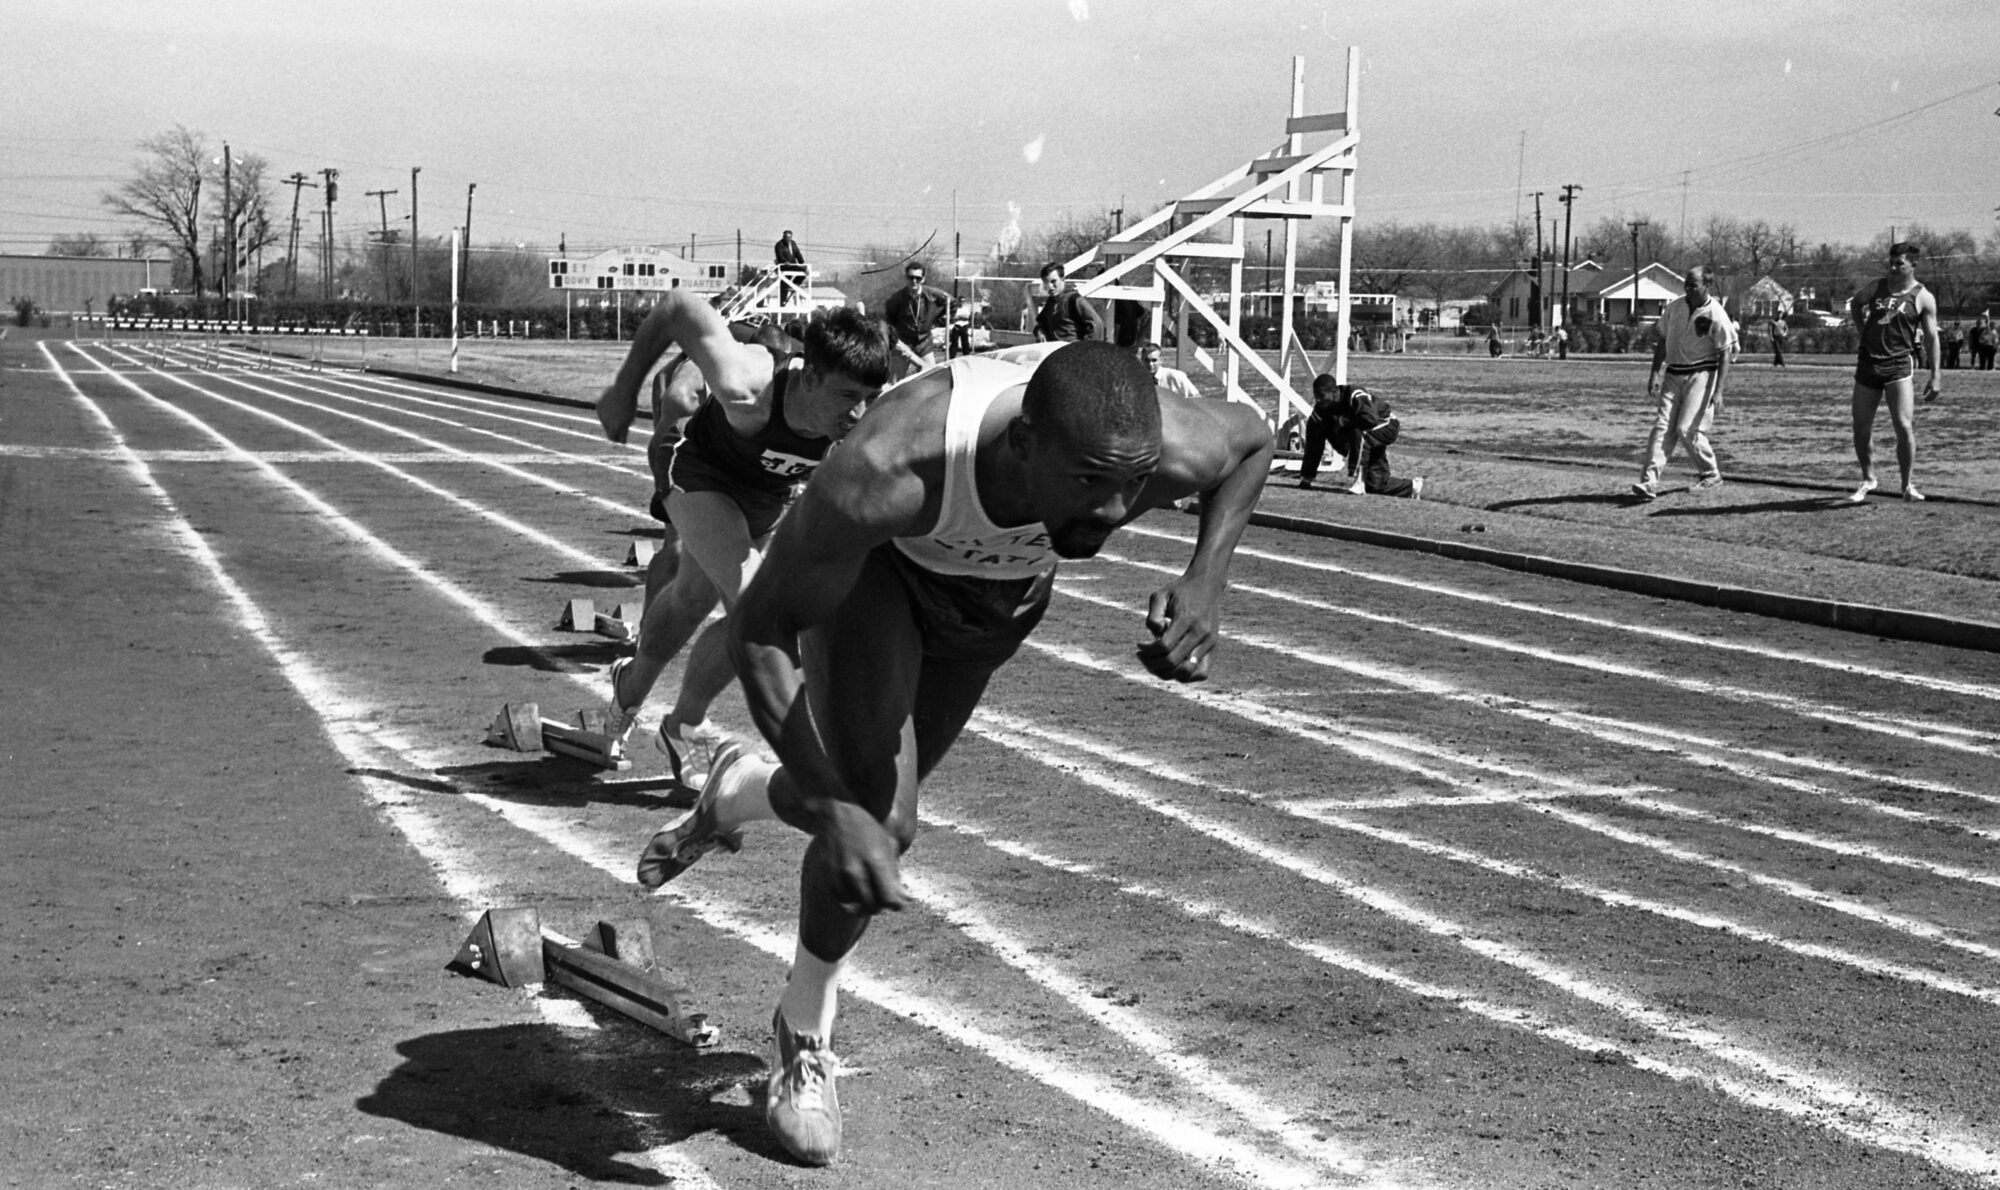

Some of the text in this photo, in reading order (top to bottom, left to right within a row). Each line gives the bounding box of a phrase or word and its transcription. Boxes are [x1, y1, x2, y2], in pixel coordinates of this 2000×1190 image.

[564, 276, 591, 285] DOWN
[639, 277, 649, 287] TO
[652, 277, 664, 288] GO
[681, 278, 722, 289] QUARTER
